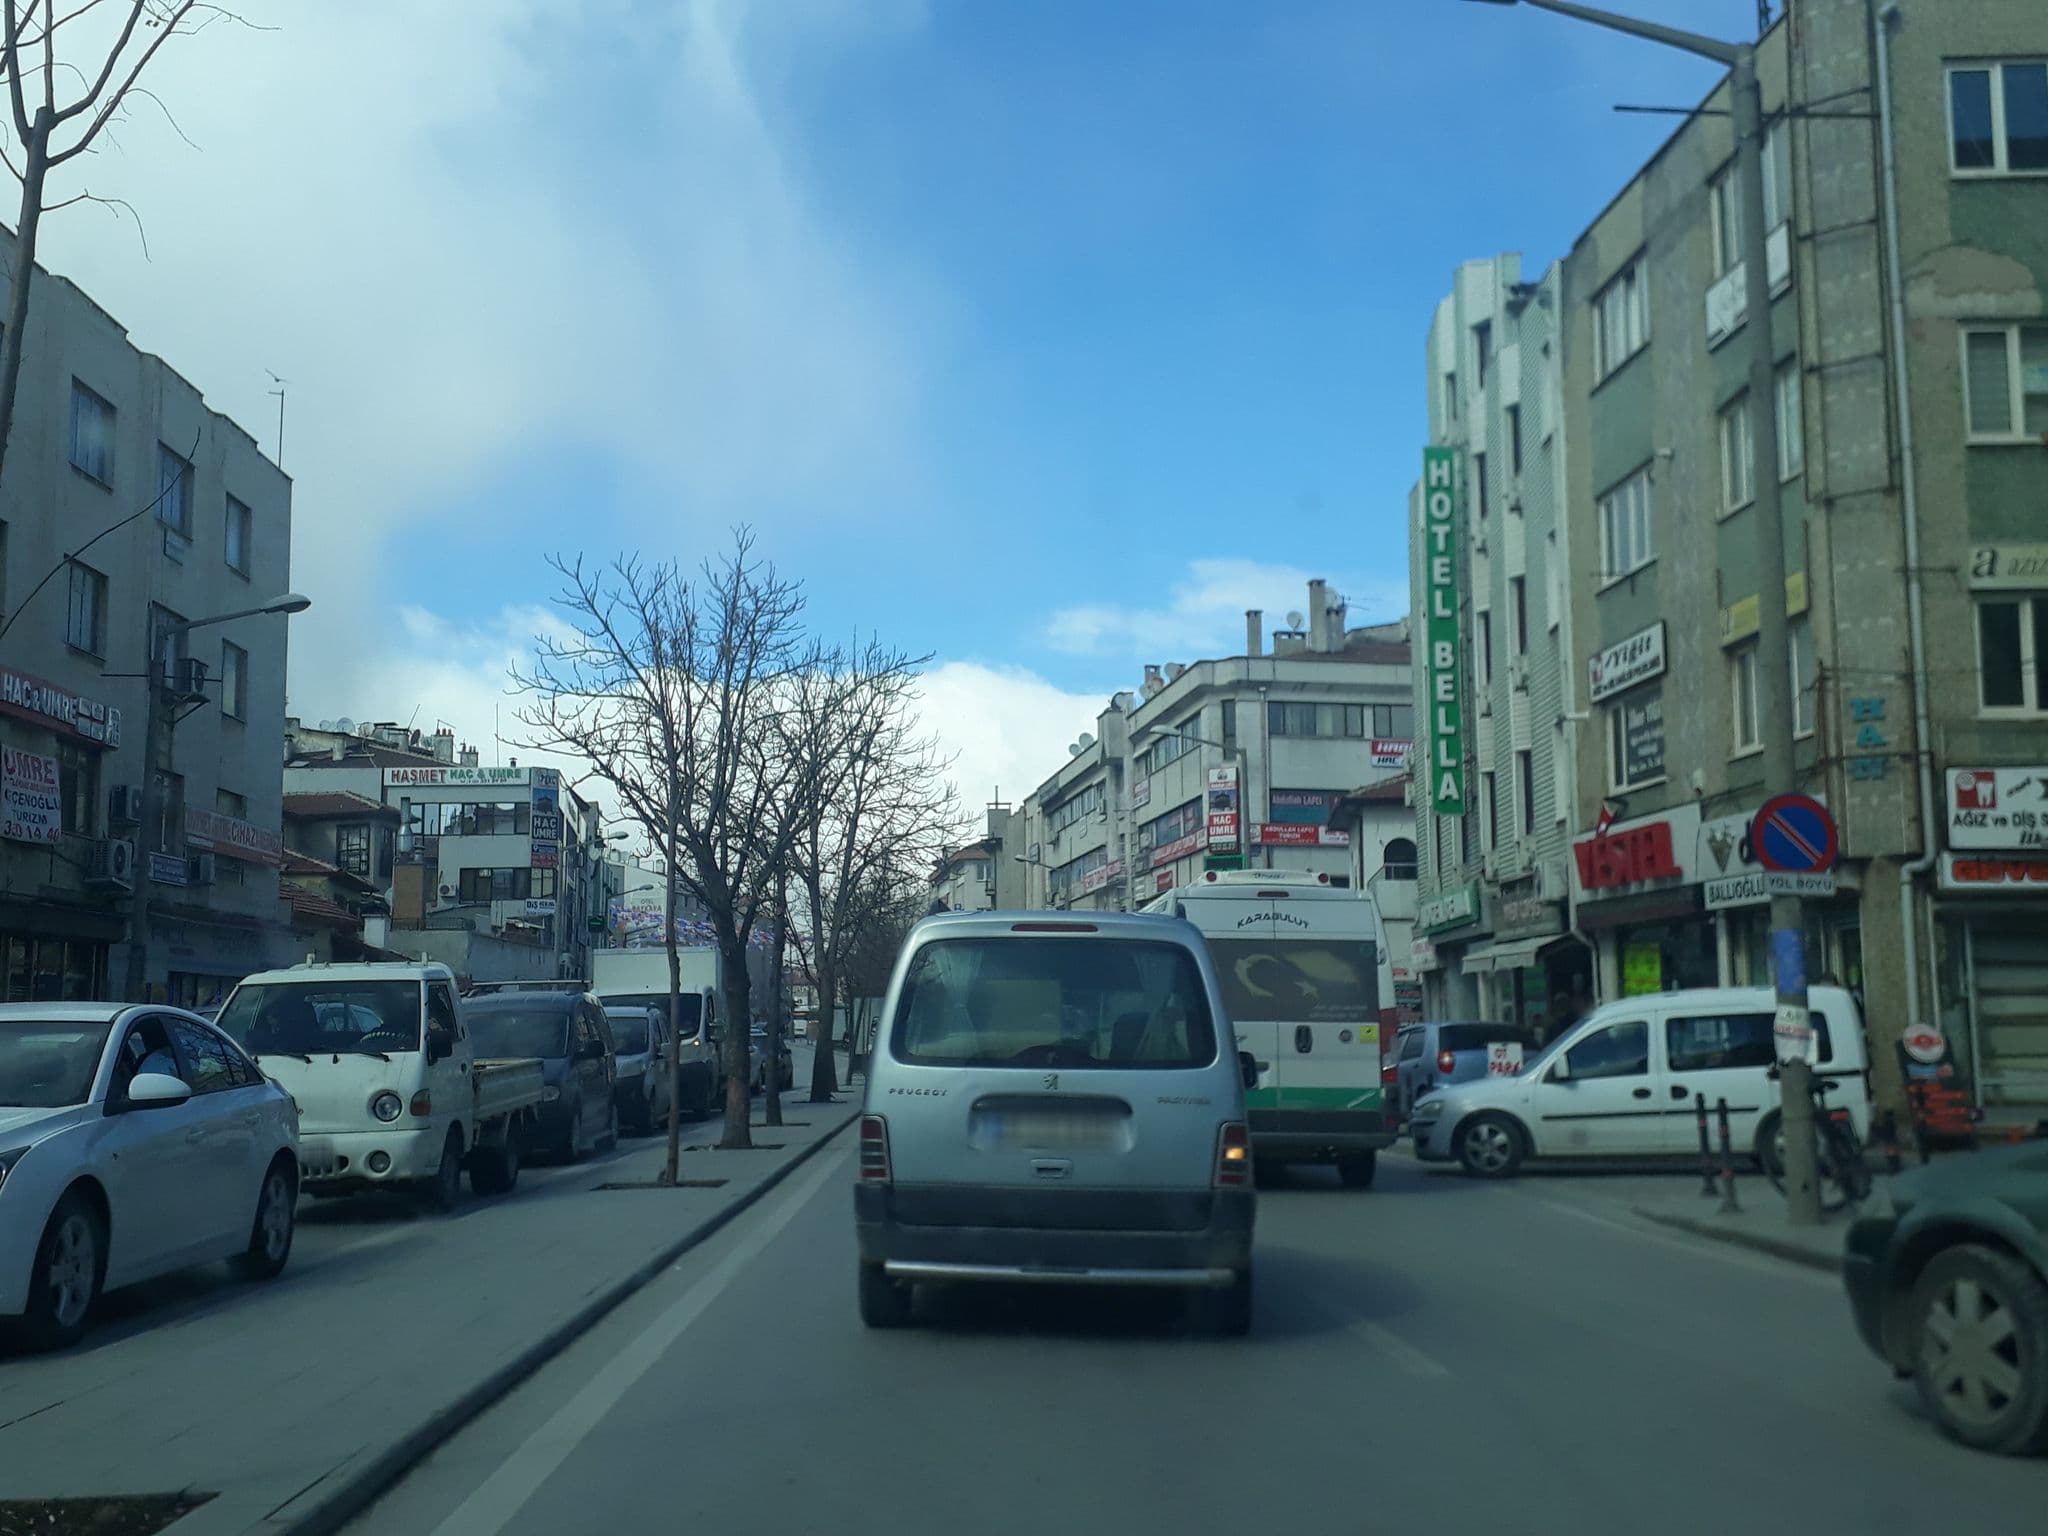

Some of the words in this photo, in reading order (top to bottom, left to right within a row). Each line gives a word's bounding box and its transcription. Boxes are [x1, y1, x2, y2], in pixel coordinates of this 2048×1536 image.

[1428, 459, 1452, 618] HOTEL
[4, 672, 32, 708] HAC
[41, 687, 78, 725] UMRE
[1434, 640, 1459, 802] BELLA
[534, 816, 557, 828] HAC
[1213, 815, 1232, 825] HAC
[1952, 810, 1988, 828] AĞIZ
[1992, 814, 2008, 826] ve
[2012, 810, 2036, 829] DİŞ
[533, 828, 557, 840] UMRE
[1210, 825, 1235, 835] UMRE
[1237, 912, 1311, 929] KARABULUT
[888, 1087, 948, 1097] PEUGEOT
